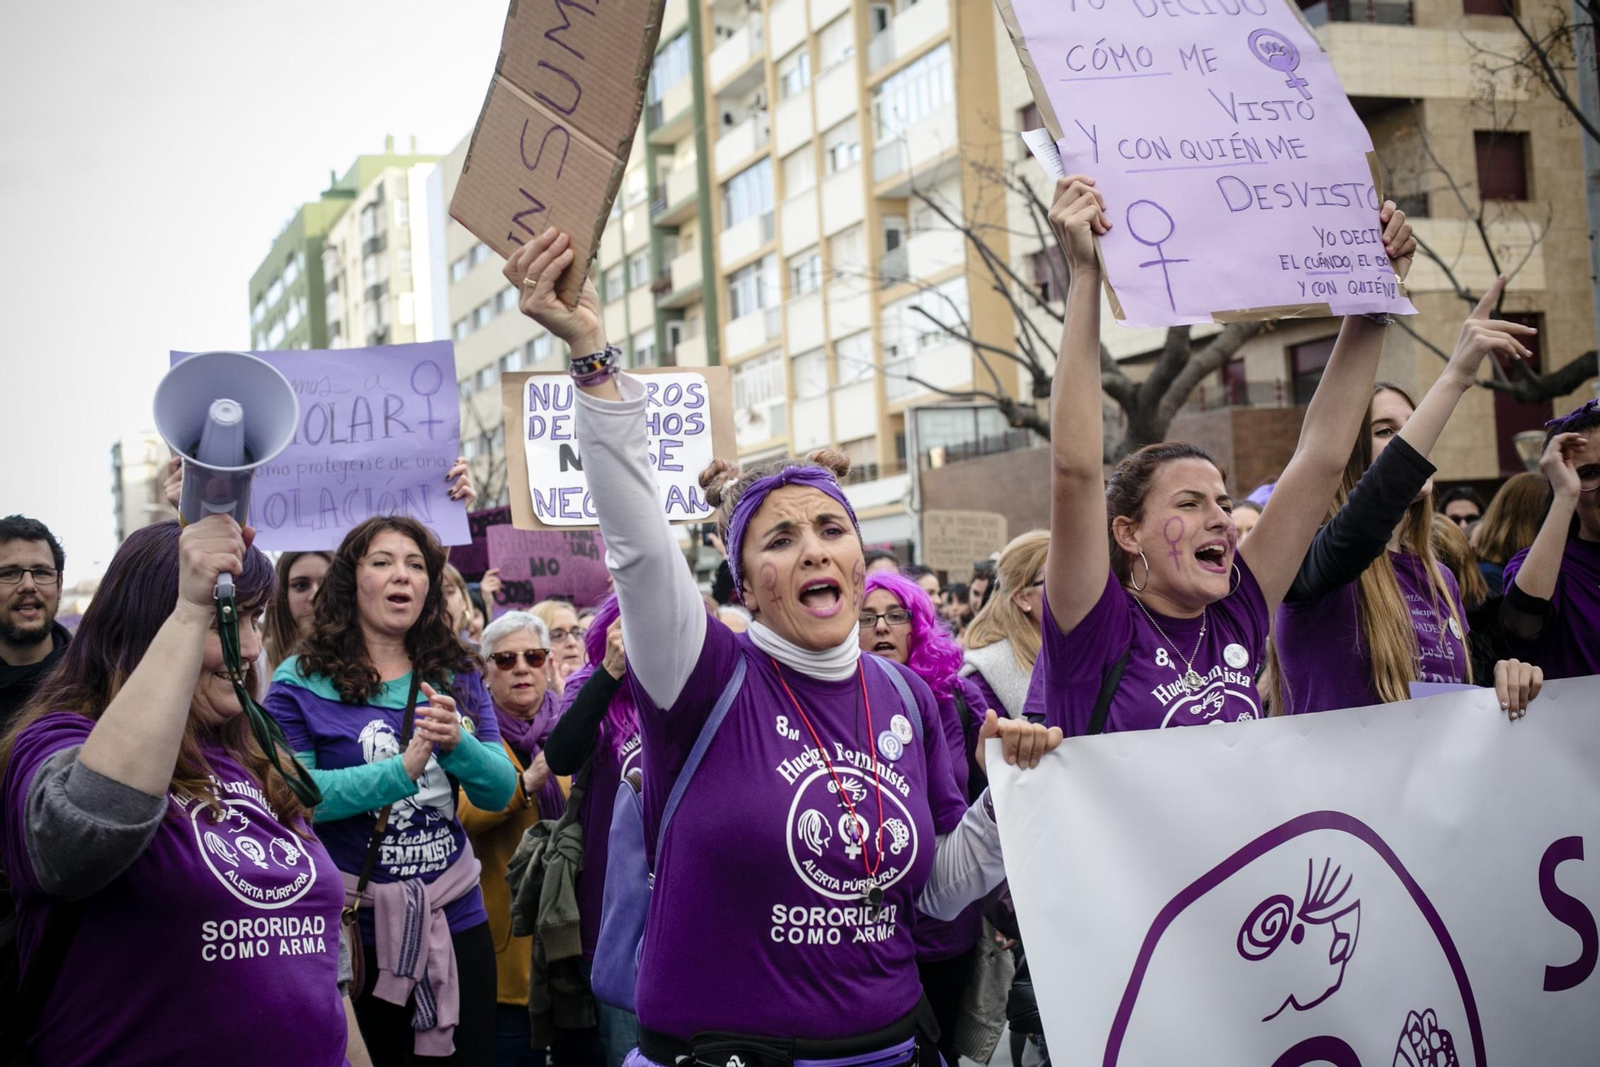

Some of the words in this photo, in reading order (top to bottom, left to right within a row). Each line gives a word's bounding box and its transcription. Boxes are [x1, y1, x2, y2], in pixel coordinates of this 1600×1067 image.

[1066, 37, 1153, 72] CÓMO
[1179, 43, 1218, 75] ME
[507, 0, 598, 246] INSUM
[1074, 119, 1099, 164] Y
[1117, 136, 1172, 161] CON
[1179, 132, 1263, 163] QUIÉN
[1265, 135, 1308, 161] ME
[1312, 226, 1337, 248] YO
[1340, 228, 1381, 246] DECI
[1279, 254, 1300, 271] EL
[1357, 254, 1372, 267] EL
[1297, 280, 1306, 298] Y
[1311, 280, 1338, 297] CON
[529, 382, 706, 412] NUROS
[291, 393, 416, 447] OLAR
[529, 412, 706, 441] DEHOS
[254, 463, 290, 477] omo
[296, 455, 385, 486] protegerse
[390, 454, 409, 471] de
[416, 456, 448, 470] una
[529, 556, 560, 577] NO
[400, 863, 419, 877] no
[802, 859, 840, 892] ALERTA
[224, 869, 264, 900] ALERTA
[266, 872, 309, 901] PÚRPURA
[1539, 835, 1599, 992] S
[201, 915, 326, 942] SORORIDAD
[770, 925, 842, 946] COMO
[852, 923, 896, 944] ARMA
[201, 939, 270, 962] COMO
[279, 936, 327, 956] ARMA
